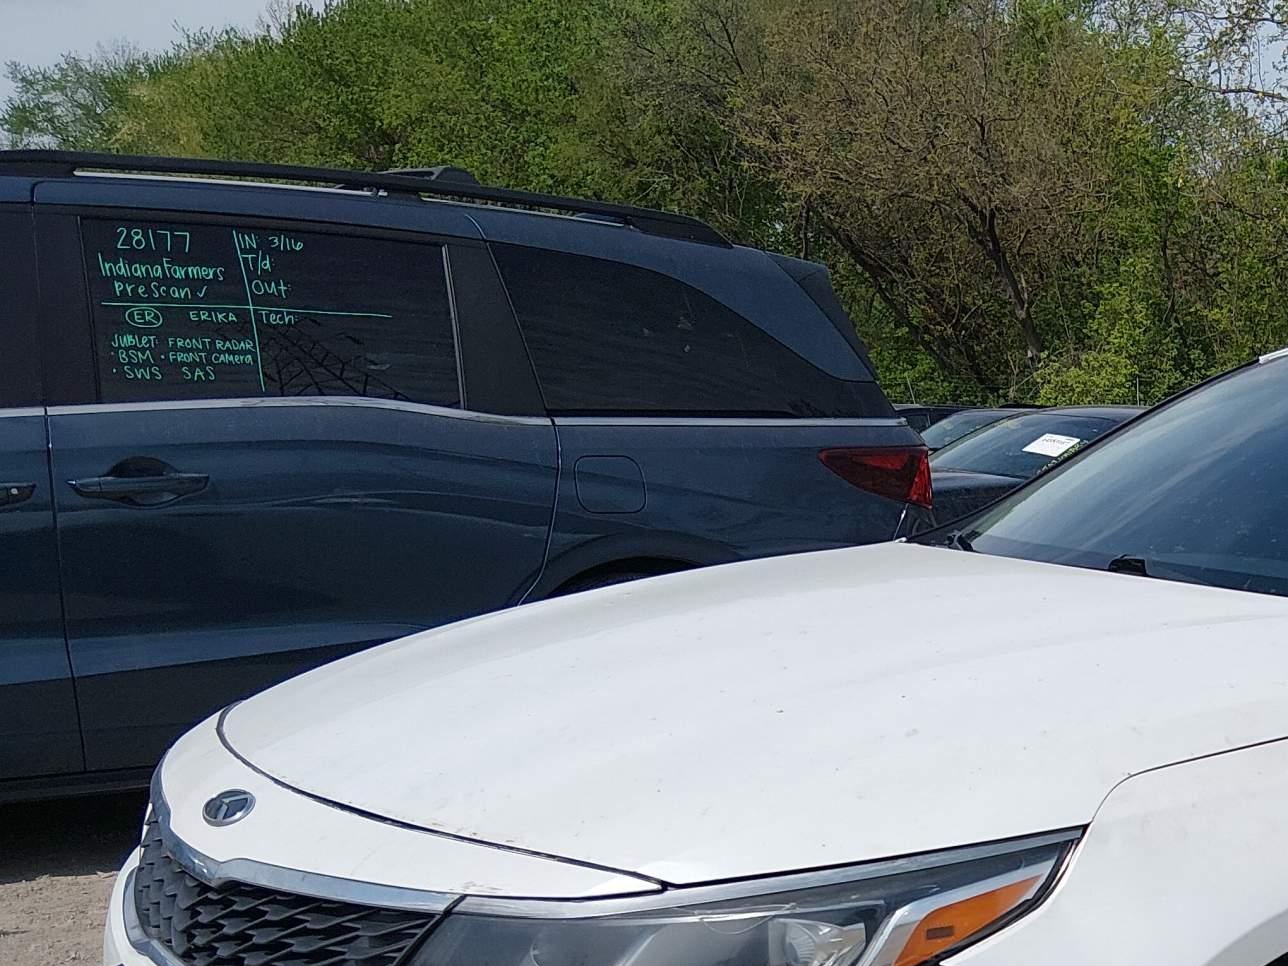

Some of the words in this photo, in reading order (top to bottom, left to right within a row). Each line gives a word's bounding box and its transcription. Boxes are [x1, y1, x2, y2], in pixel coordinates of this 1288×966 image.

[116, 227, 190, 253] 28177
[268, 234, 304, 251] 3/16
[133, 310, 159, 324] ER
[190, 310, 238, 323] ERIKA
[168, 337, 211, 350] FRONT
[215, 338, 256, 352] RADAR
[118, 350, 154, 364] BSM
[169, 351, 207, 364] FRONT
[124, 366, 163, 380] SWS
[181, 366, 216, 381] SAS
